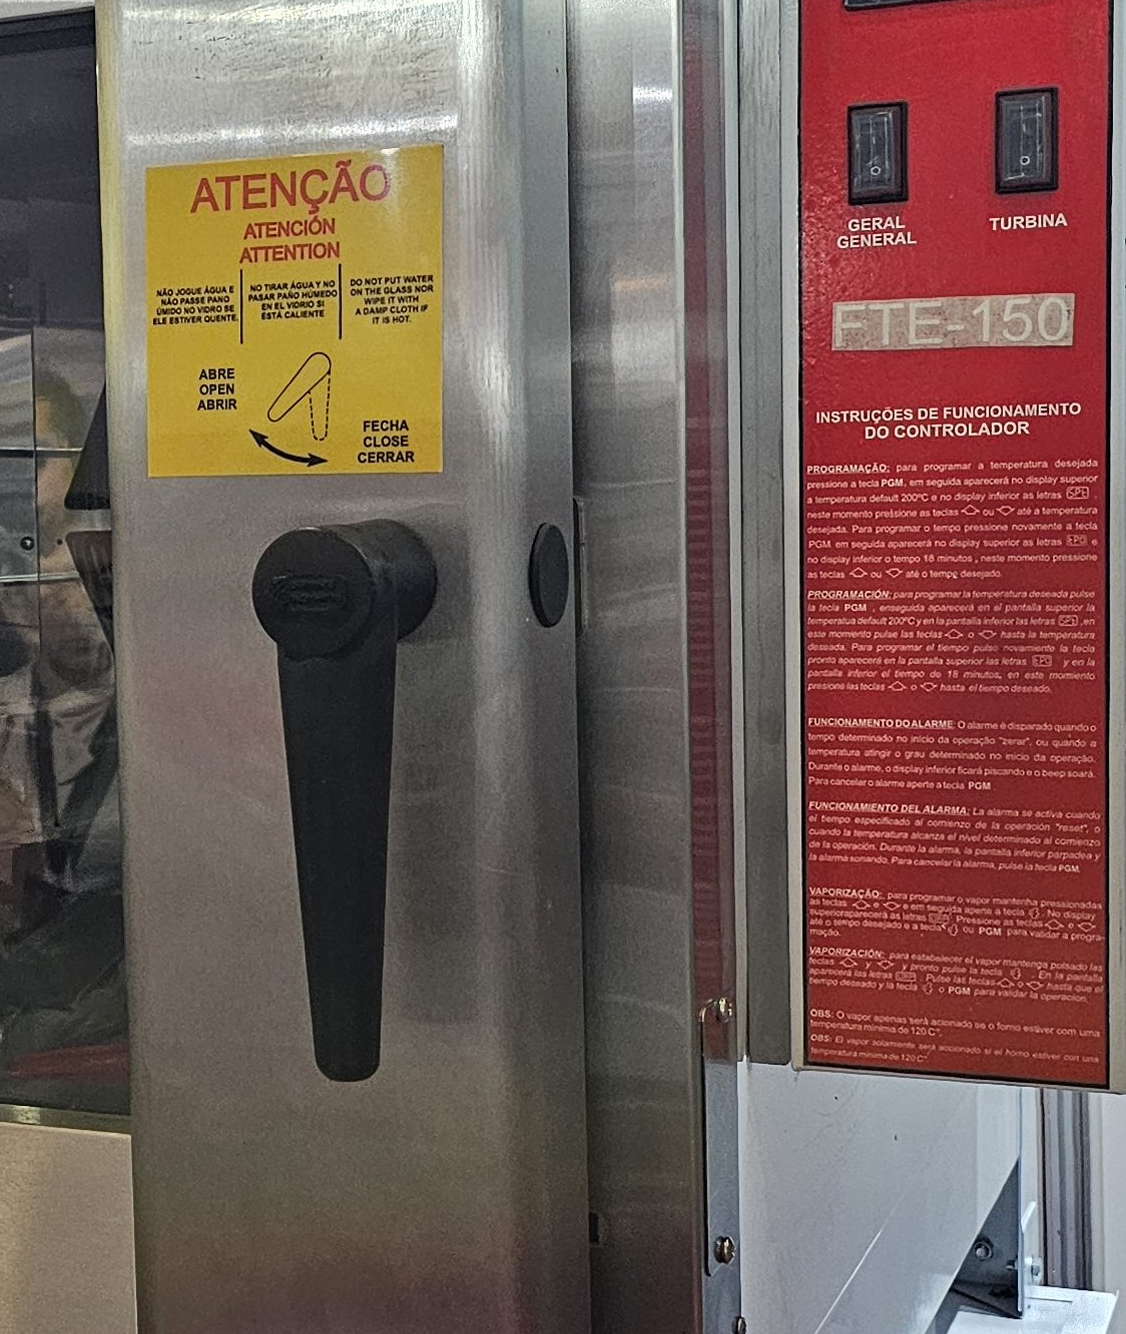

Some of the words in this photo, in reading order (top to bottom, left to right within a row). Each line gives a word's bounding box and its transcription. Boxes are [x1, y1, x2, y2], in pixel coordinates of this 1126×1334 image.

[190, 160, 390, 214] ATENÇÃO
[243, 215, 335, 239] ATENCIÓN
[848, 216, 905, 231] GERAL
[988, 213, 1067, 230] TURBINA
[836, 231, 917, 248] GENERAL
[239, 241, 339, 263] ATTENTION
[250, 283, 262, 292] NO
[264, 282, 288, 291] TIRAR
[288, 280, 314, 292] ÁGUA
[314, 280, 322, 291] Y
[321, 279, 336, 291] NO
[350, 278, 362, 286] DO
[364, 277, 382, 285] NOT
[384, 275, 401, 284] PUT
[403, 274, 433, 283] WATER
[156, 287, 173, 296] NÃO
[175, 287, 201, 296] JOGUE
[203, 285, 227, 296] ÁGUA
[228, 285, 234, 293] E
[248, 290, 275, 301] PASAR
[277, 289, 300, 299] PAÑO
[301, 289, 339, 298] HÚMEDO
[350, 288, 362, 296] ON
[364, 286, 381, 295] THE
[383, 285, 412, 294] GLASS
[414, 284, 434, 293] NOR
[159, 294, 178, 306] NÃO
[180, 294, 205, 305] PASSE
[207, 295, 230, 303] PANO
[261, 302, 272, 311] EN
[274, 301, 285, 311] EL
[316, 299, 324, 307] SI
[363, 296, 385, 305] WIPE
[387, 295, 395, 304] IT
[397, 295, 419, 303] WITH
[156, 304, 182, 315] ÚMIDO
[183, 305, 195, 314] NO
[196, 304, 222, 313] VIDRO
[224, 304, 234, 312] SE
[284, 309, 324, 318] CALIENTE
[355, 307, 361, 315] A
[362, 306, 388, 315] DAMP
[389, 305, 418, 313] CLOTH
[420, 303, 428, 312] IF
[152, 316, 167, 325] ELE
[169, 315, 202, 324] ESTIVER
[372, 316, 379, 324] IT
[382, 315, 390, 324] IS
[834, 297, 1069, 348] FTE-150
[198, 367, 235, 380] ABRE
[199, 383, 234, 395] OPEN
[197, 398, 237, 410] ABRIR
[816, 407, 913, 423] INSTRUÇÕES
[917, 407, 938, 420] DE
[943, 402, 1081, 418] FUNCIONAMENTO
[363, 419, 409, 432] FECHA
[865, 425, 889, 439] DO
[894, 421, 1029, 437] CONTROLADOR
[363, 435, 409, 447] CLOSE
[357, 450, 414, 463] CERRAR
[807, 463, 890, 474] PROGRAMAÇÃO:
[896, 464, 917, 473] para
[923, 463, 971, 472] programar
[990, 460, 1048, 470] temperatura
[1054, 458, 1098, 468] desejada
[807, 589, 891, 600] PROGRAMACIÓN:
[844, 603, 866, 611] PGM
[808, 717, 894, 727] FUNCIONAMENTO
[895, 719, 910, 728] DO
[808, 801, 899, 813] FUNCIONAMIENTO
[900, 804, 921, 814] DEL
[978, 926, 1001, 935] PGM
[948, 986, 970, 995] PGM
[809, 1008, 834, 1018] OBS:
[835, 1010, 845, 1019] O
